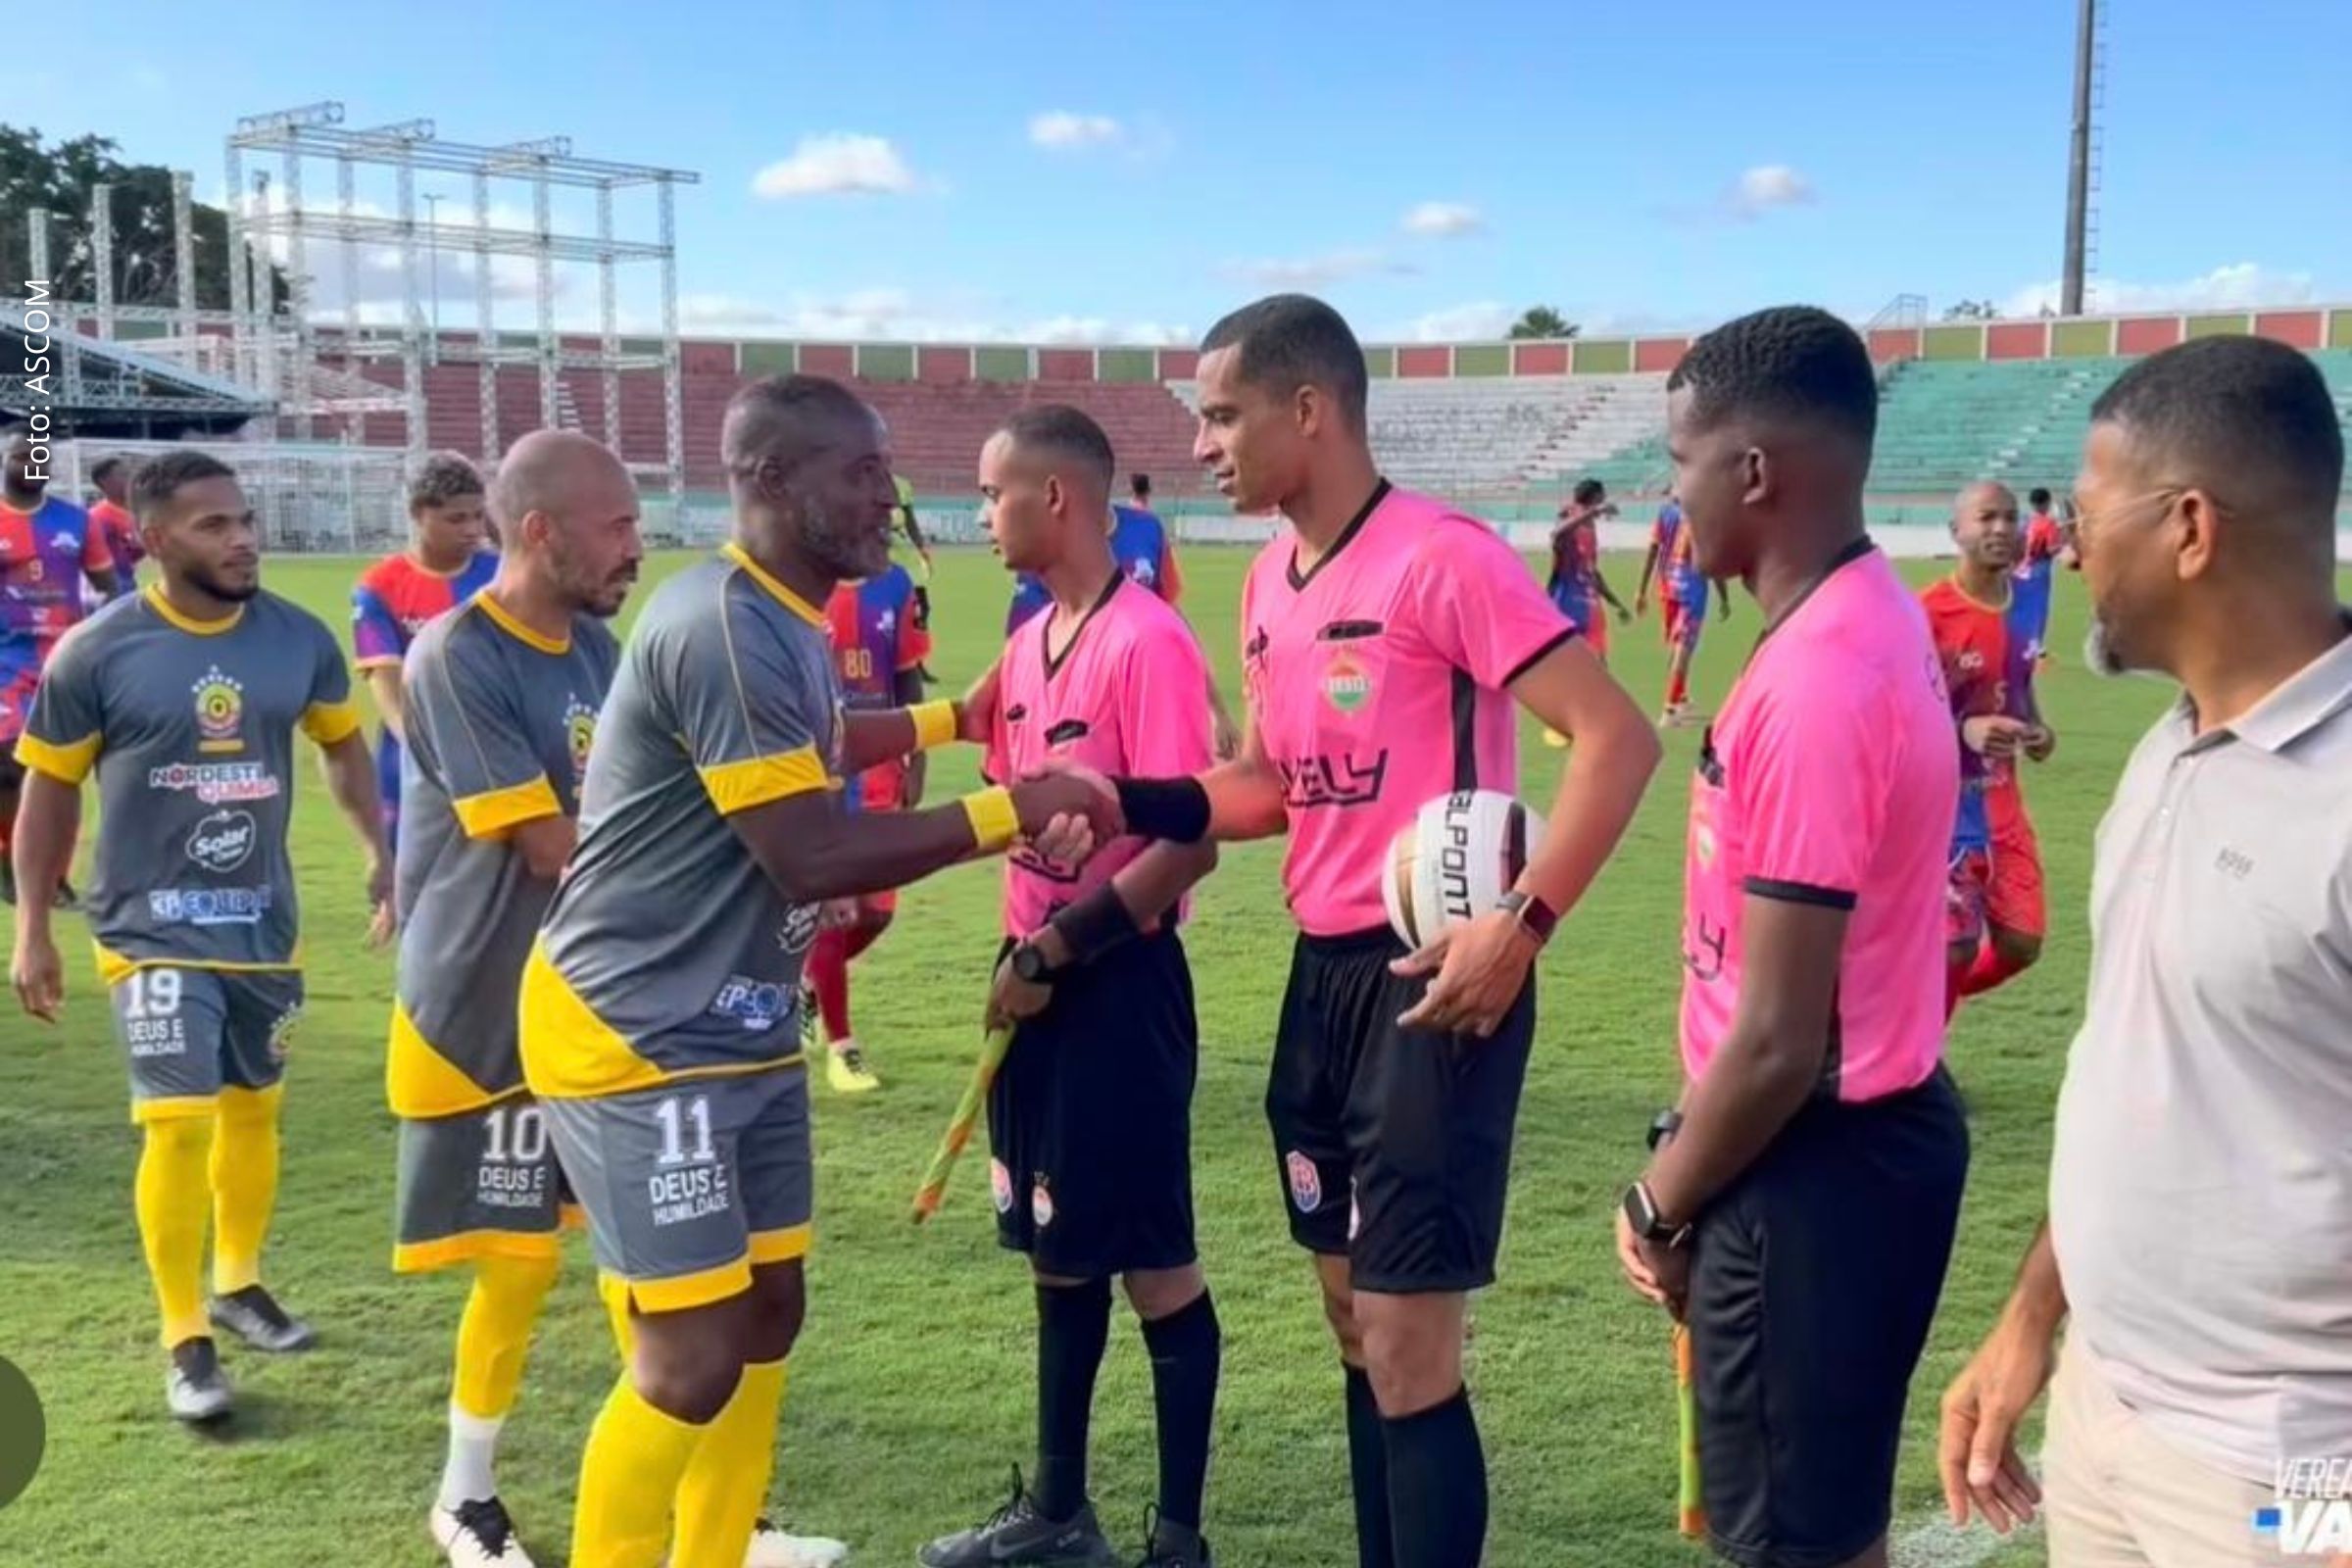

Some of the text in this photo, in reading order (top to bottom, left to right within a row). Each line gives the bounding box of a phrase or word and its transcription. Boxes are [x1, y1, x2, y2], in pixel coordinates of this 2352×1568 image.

[125, 968, 182, 1019] 19
[172, 1017, 184, 1040] E
[483, 1107, 547, 1162] 10
[655, 1097, 715, 1164] 11
[478, 1165, 547, 1191] DEUS E
[648, 1168, 711, 1205] DEUS
